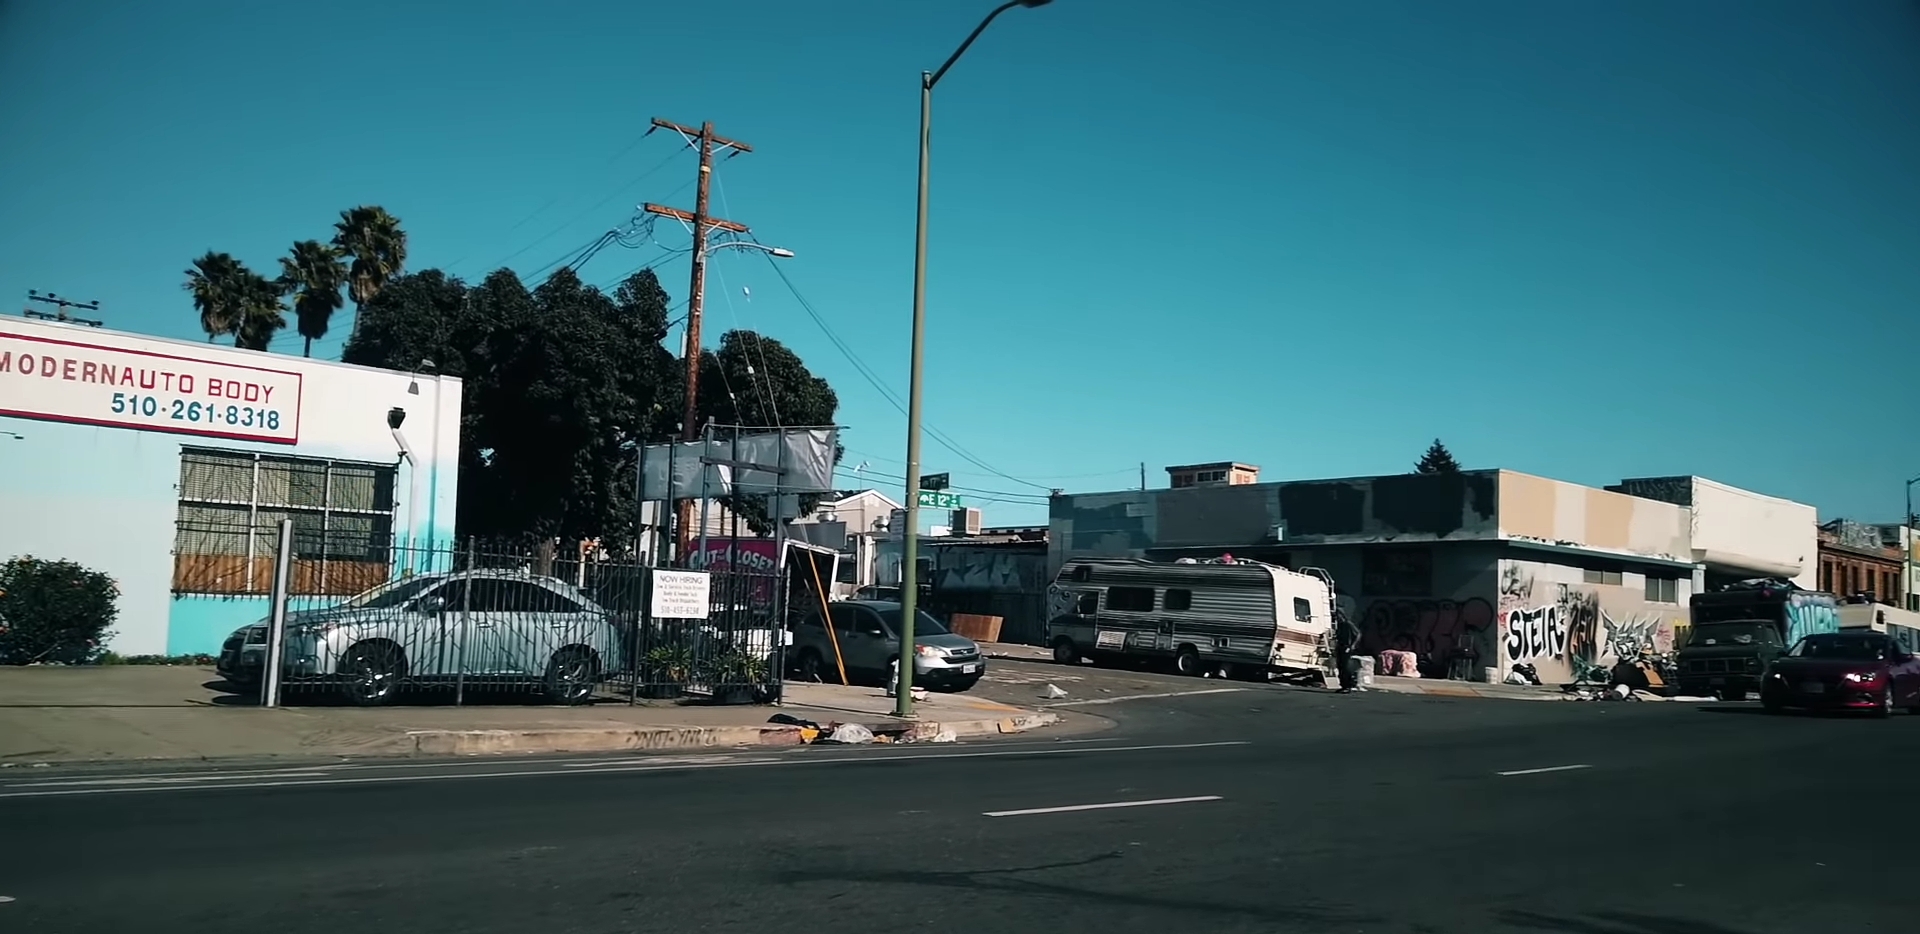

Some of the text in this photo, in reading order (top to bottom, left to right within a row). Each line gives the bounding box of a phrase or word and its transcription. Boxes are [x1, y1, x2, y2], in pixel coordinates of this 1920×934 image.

[208, 378, 274, 403] BODY
[929, 494, 935, 505] E
[689, 549, 718, 570] OUT
[725, 544, 774, 570] CLOSET
[660, 575, 703, 584] NOW HIRING
